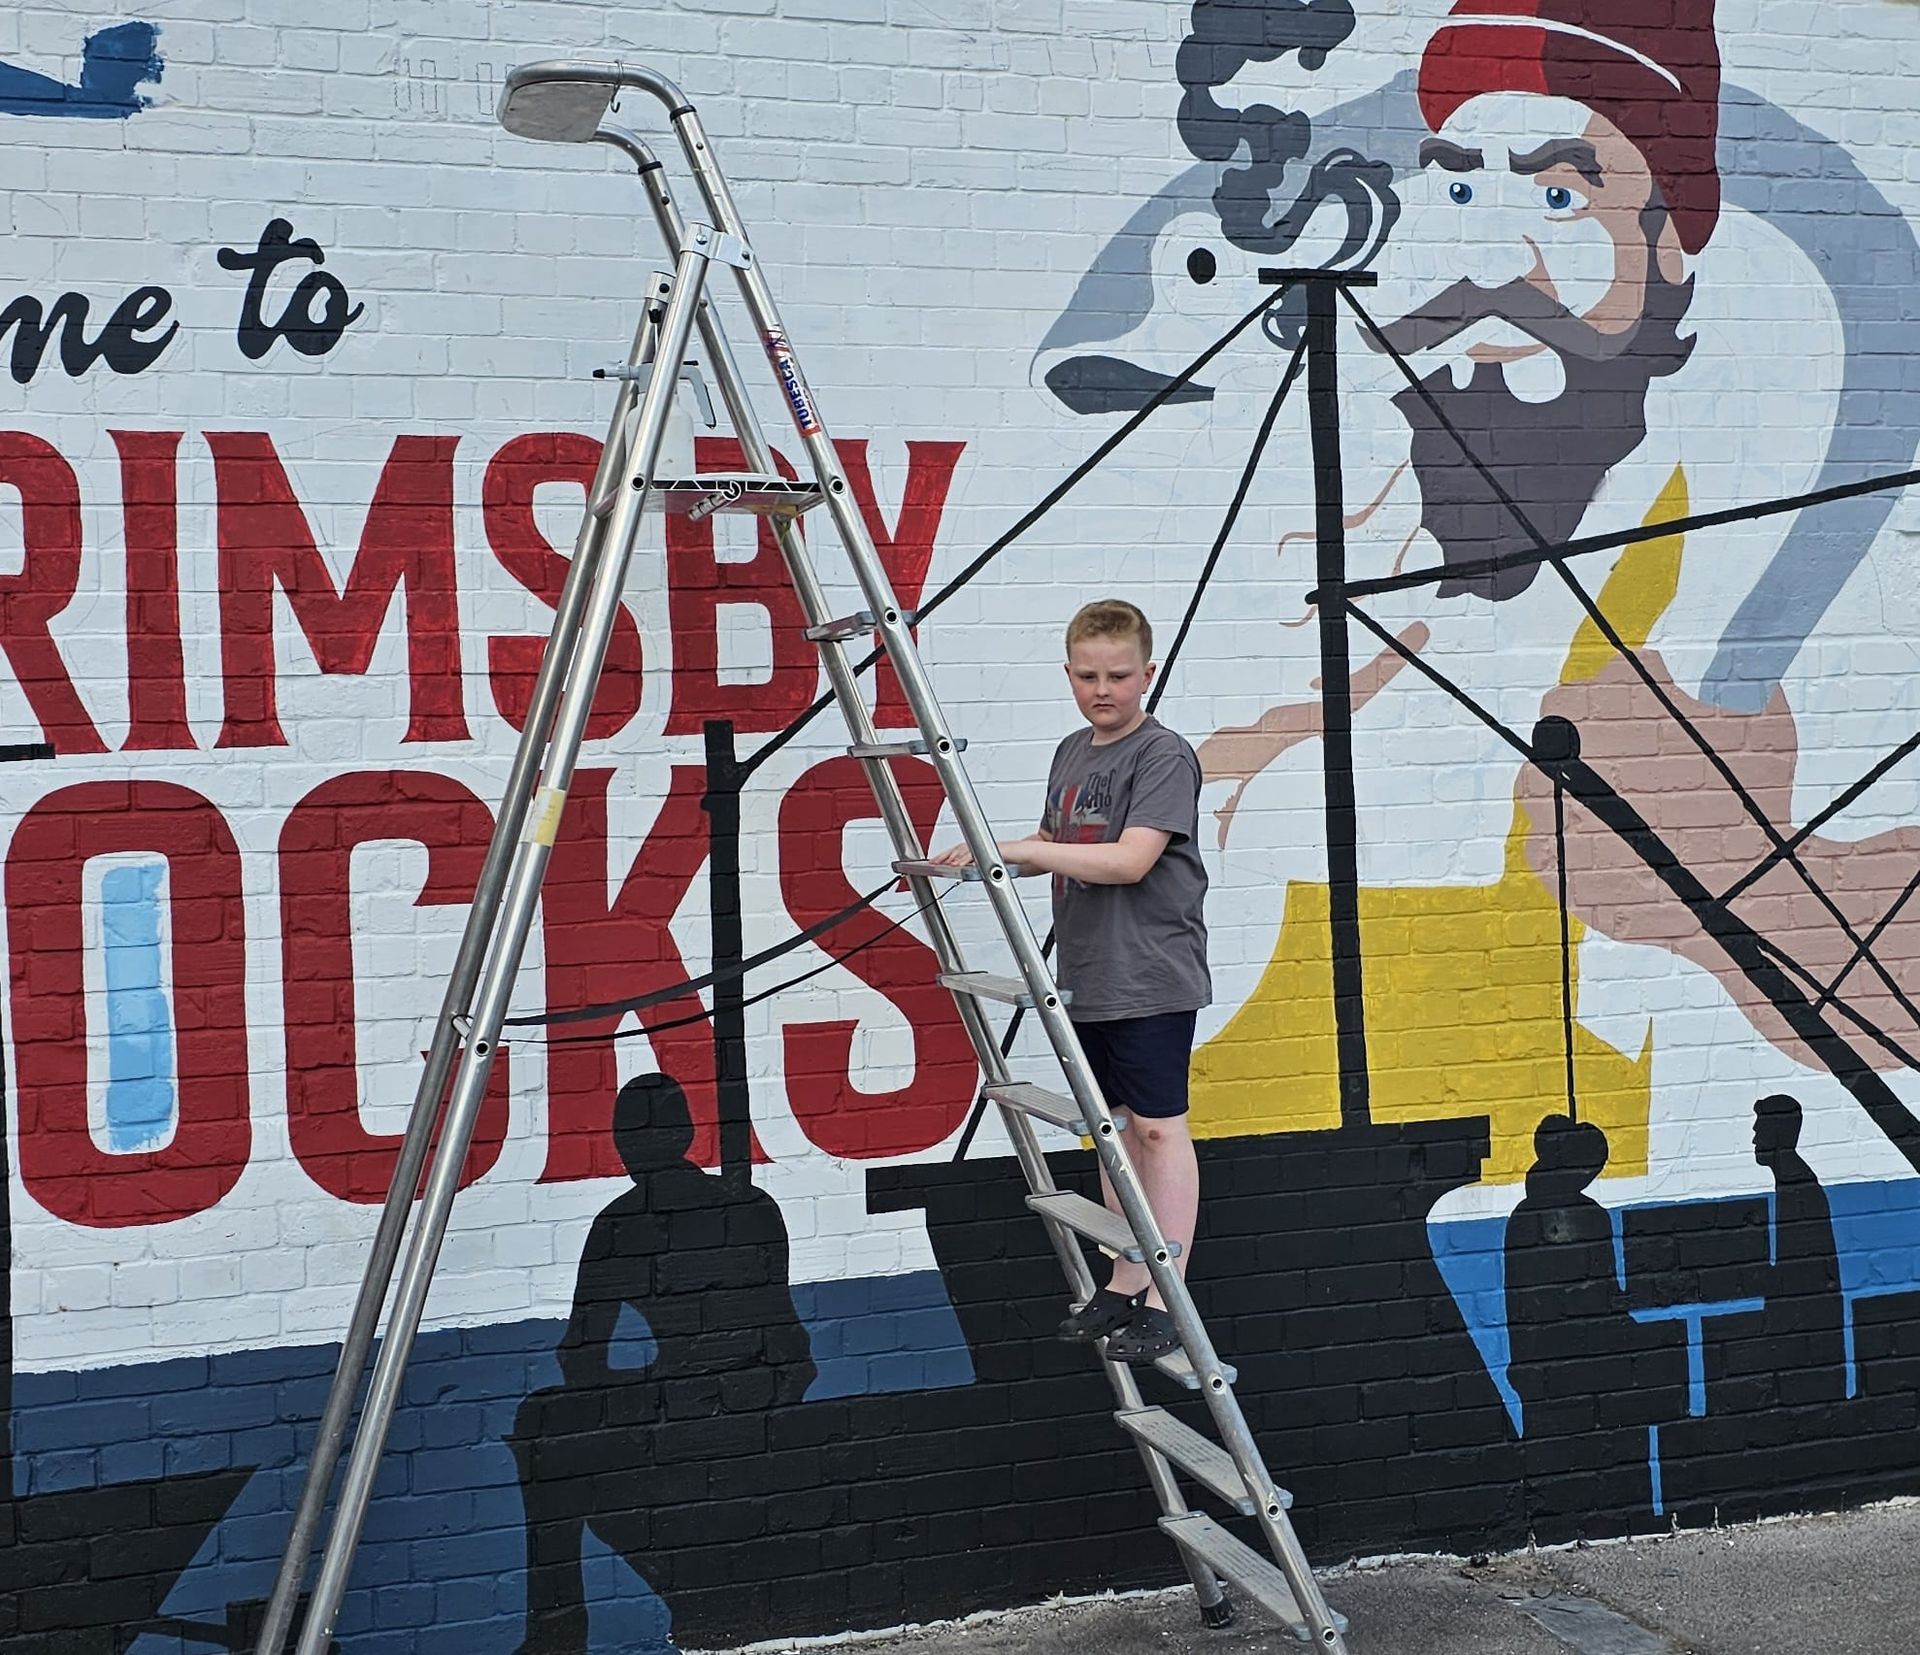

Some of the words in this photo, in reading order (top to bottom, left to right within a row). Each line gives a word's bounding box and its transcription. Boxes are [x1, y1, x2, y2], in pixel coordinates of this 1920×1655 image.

[217, 218, 364, 360] to
[779, 358, 813, 428] TUBESCA
[6, 757, 981, 1228] OCKS
